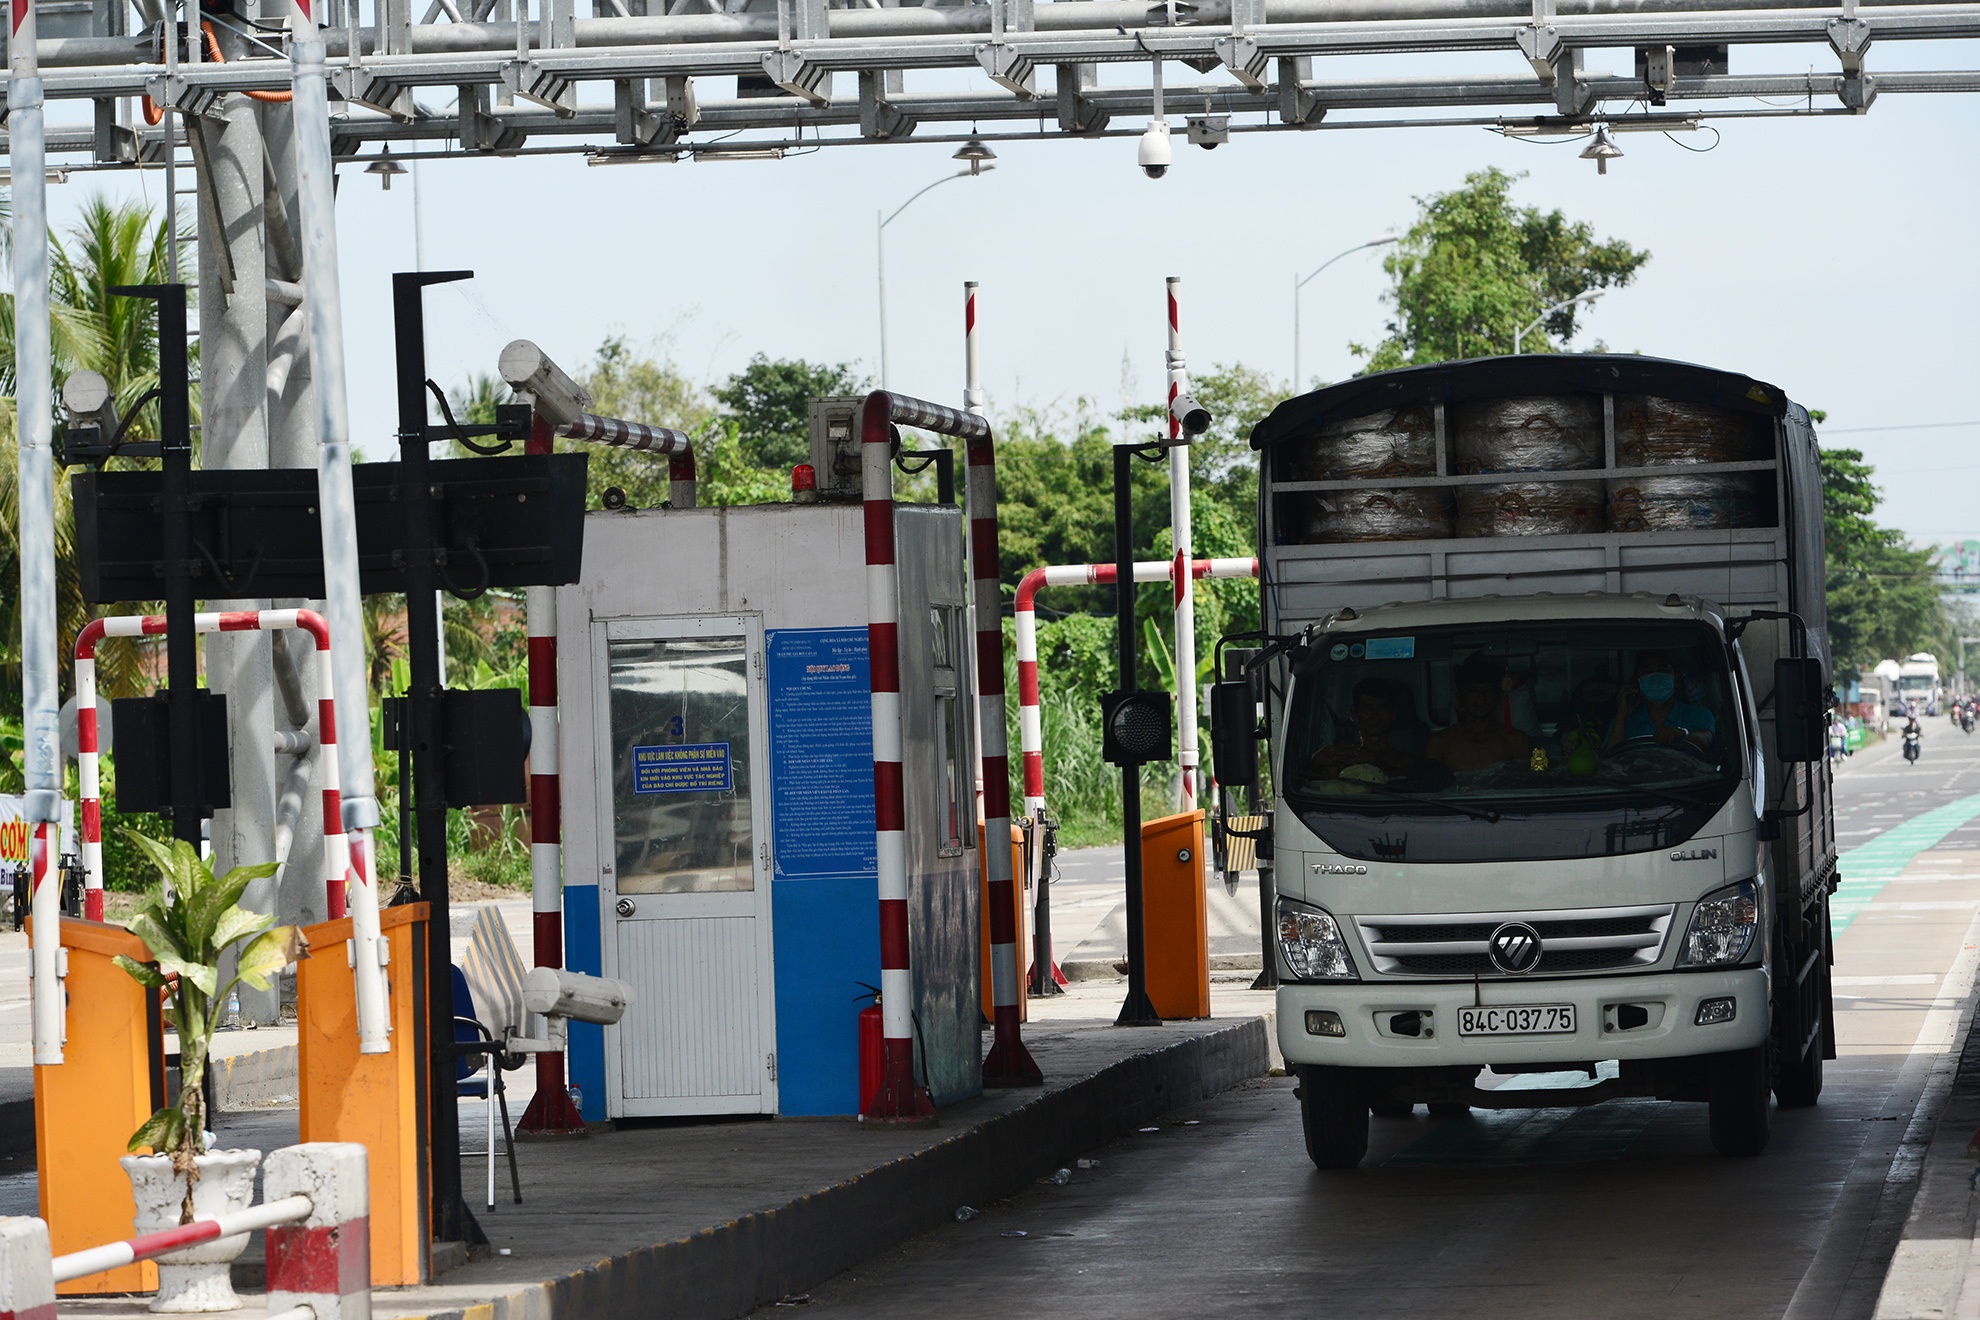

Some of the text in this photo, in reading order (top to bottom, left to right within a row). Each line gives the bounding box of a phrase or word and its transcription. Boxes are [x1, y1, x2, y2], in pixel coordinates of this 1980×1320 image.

[670, 715, 684, 736] 3
[1670, 849, 1717, 861] OLLIN
[1311, 864, 1367, 875] THACO
[1463, 1008, 1571, 1032] 84C-037.75
